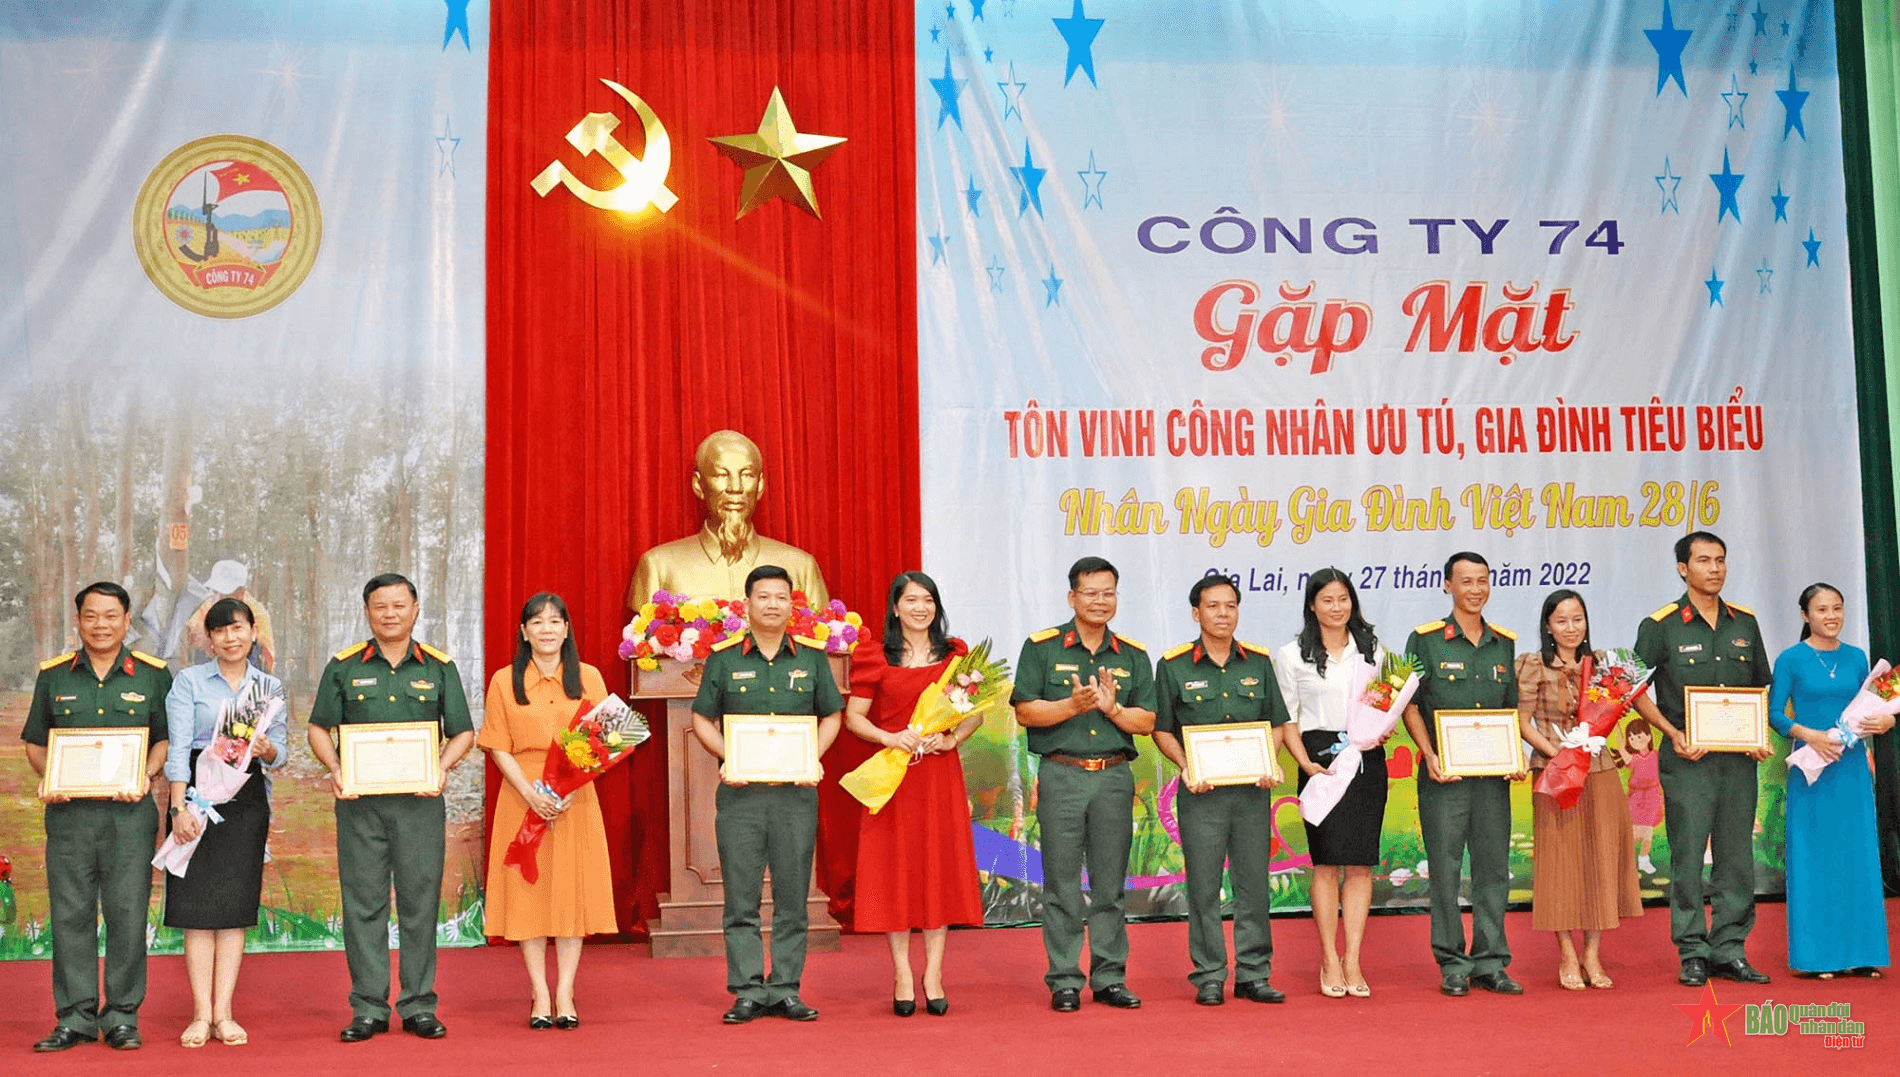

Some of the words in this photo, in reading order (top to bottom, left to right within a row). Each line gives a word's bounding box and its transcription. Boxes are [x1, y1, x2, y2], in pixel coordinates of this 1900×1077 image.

[1137, 206, 1378, 254] CÔNG
[1409, 218, 1510, 254] TY
[1539, 219, 1625, 255] 74
[206, 268, 228, 284] CÔNG
[231, 270, 241, 282] TY
[243, 272, 255, 285] 74
[1193, 278, 1373, 375] Gặp
[1401, 279, 1580, 366] Mặt
[1004, 399, 1068, 458] TÔN
[1078, 408, 1156, 457] VINH
[1166, 399, 1255, 457] CÔNG
[1266, 398, 1355, 456] NHÂN
[1366, 403, 1406, 455] ƯU
[1417, 397, 1465, 460] TÚ,
[1475, 406, 1528, 453] GIA
[1536, 397, 1612, 453] ĐÌNH
[1620, 396, 1687, 452] TIÊU
[1695, 386, 1764, 451] BIỂU
[1059, 487, 1169, 536] Nhân
[1174, 486, 1282, 548] Ngày
[1288, 486, 1356, 545] Gia
[1362, 484, 1456, 532] Đình
[1460, 483, 1536, 537] Việt
[1540, 482, 1634, 529] Nam
[1639, 480, 1721, 534] 28/6
[1249, 567, 1288, 596] Lai,
[1359, 566, 1387, 590] 27
[1393, 563, 1447, 594] thán
[1489, 562, 1531, 587] năm
[1539, 562, 1591, 586] 2022
